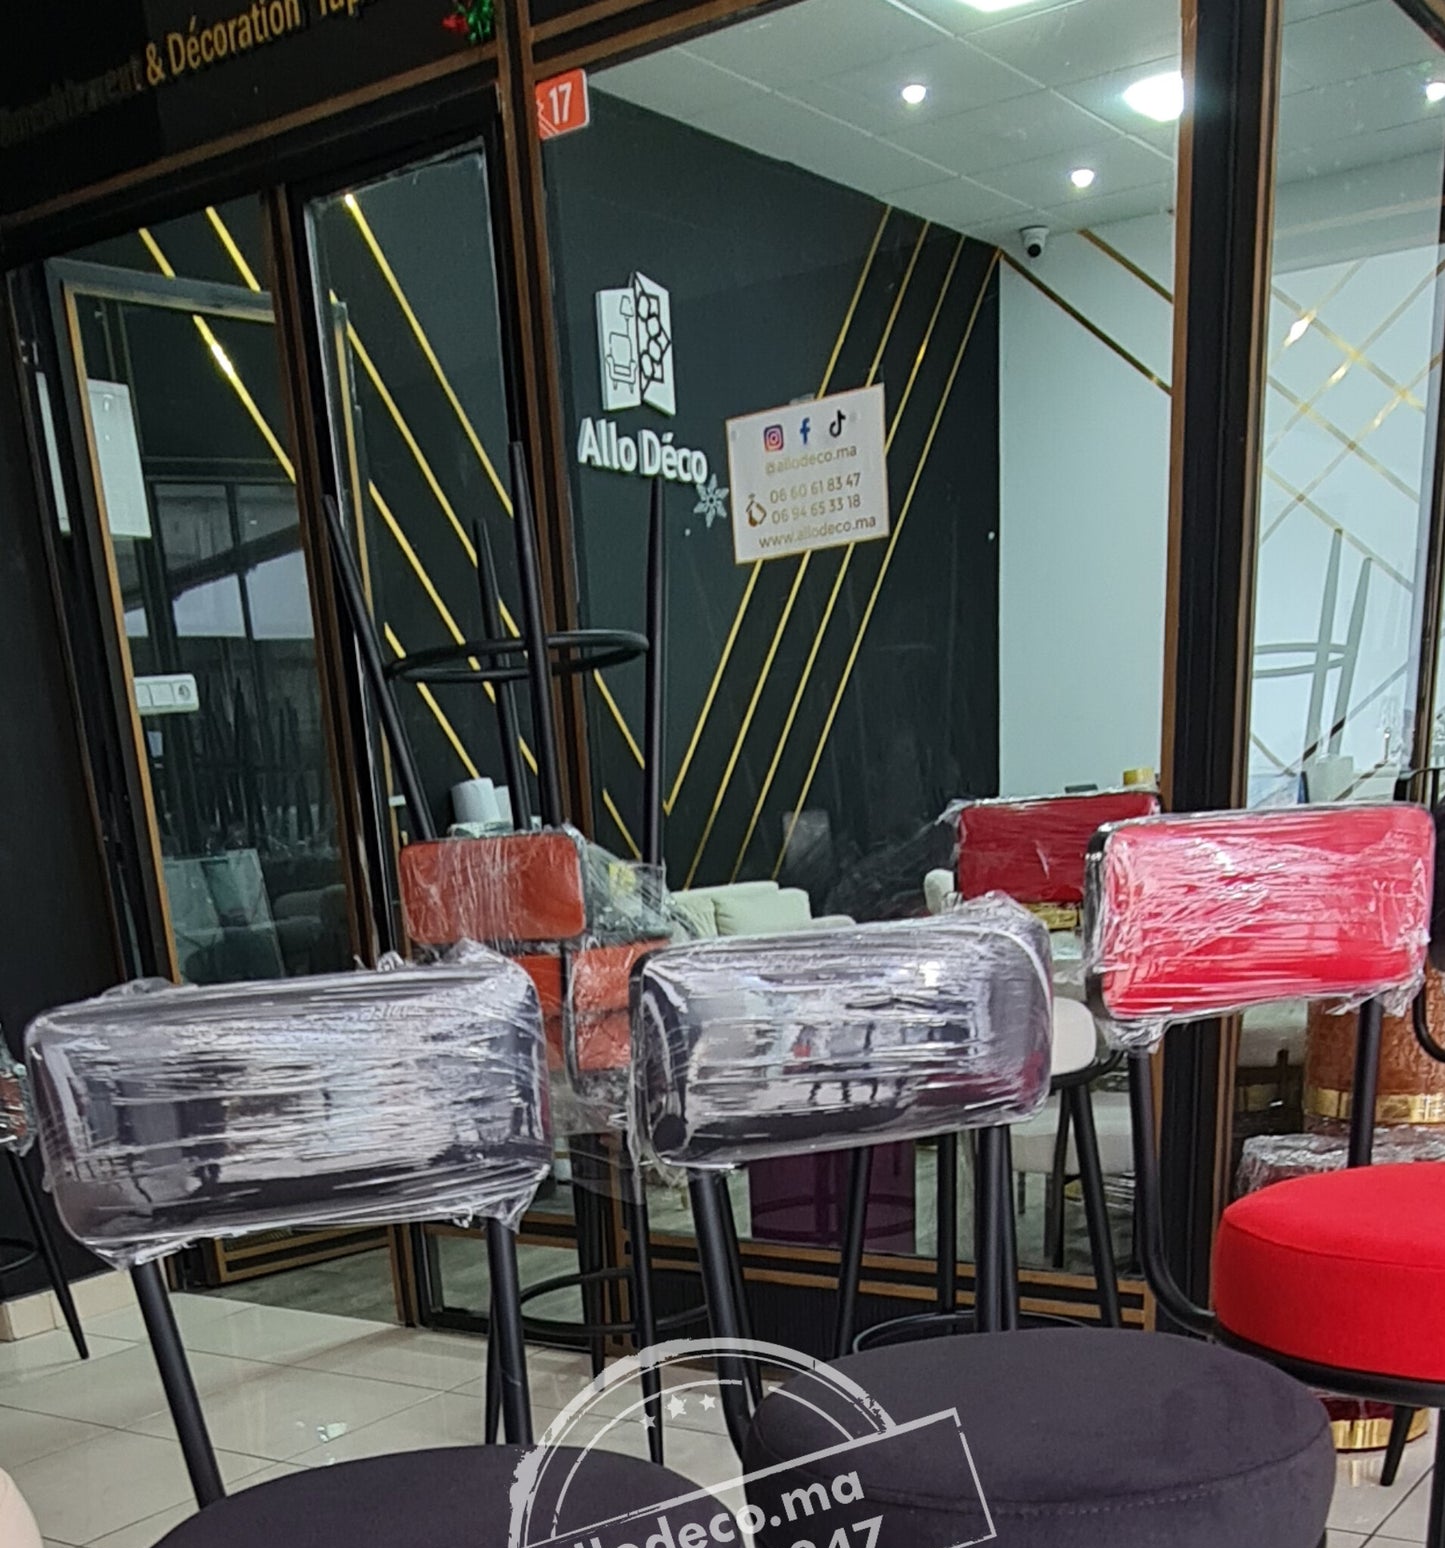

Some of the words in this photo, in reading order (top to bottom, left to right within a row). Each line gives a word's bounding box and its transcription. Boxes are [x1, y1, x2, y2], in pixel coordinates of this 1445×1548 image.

[144, 42, 165, 87] &
[167, 0, 302, 77] Décoration
[548, 81, 572, 125] 17
[578, 417, 638, 471] Allo
[638, 429, 708, 484] Déco
[765, 445, 857, 475] @allodeco.ma
[770, 488, 787, 504] 06
[790, 483, 807, 499] 60
[810, 480, 824, 496] 61
[827, 475, 843, 492] 83
[846, 472, 861, 488] 47
[771, 508, 788, 524] 06
[810, 501, 825, 517] 65
[828, 497, 844, 513] 33
[847, 493, 861, 508] 18
[759, 516, 877, 548] www.allodeco.ma
